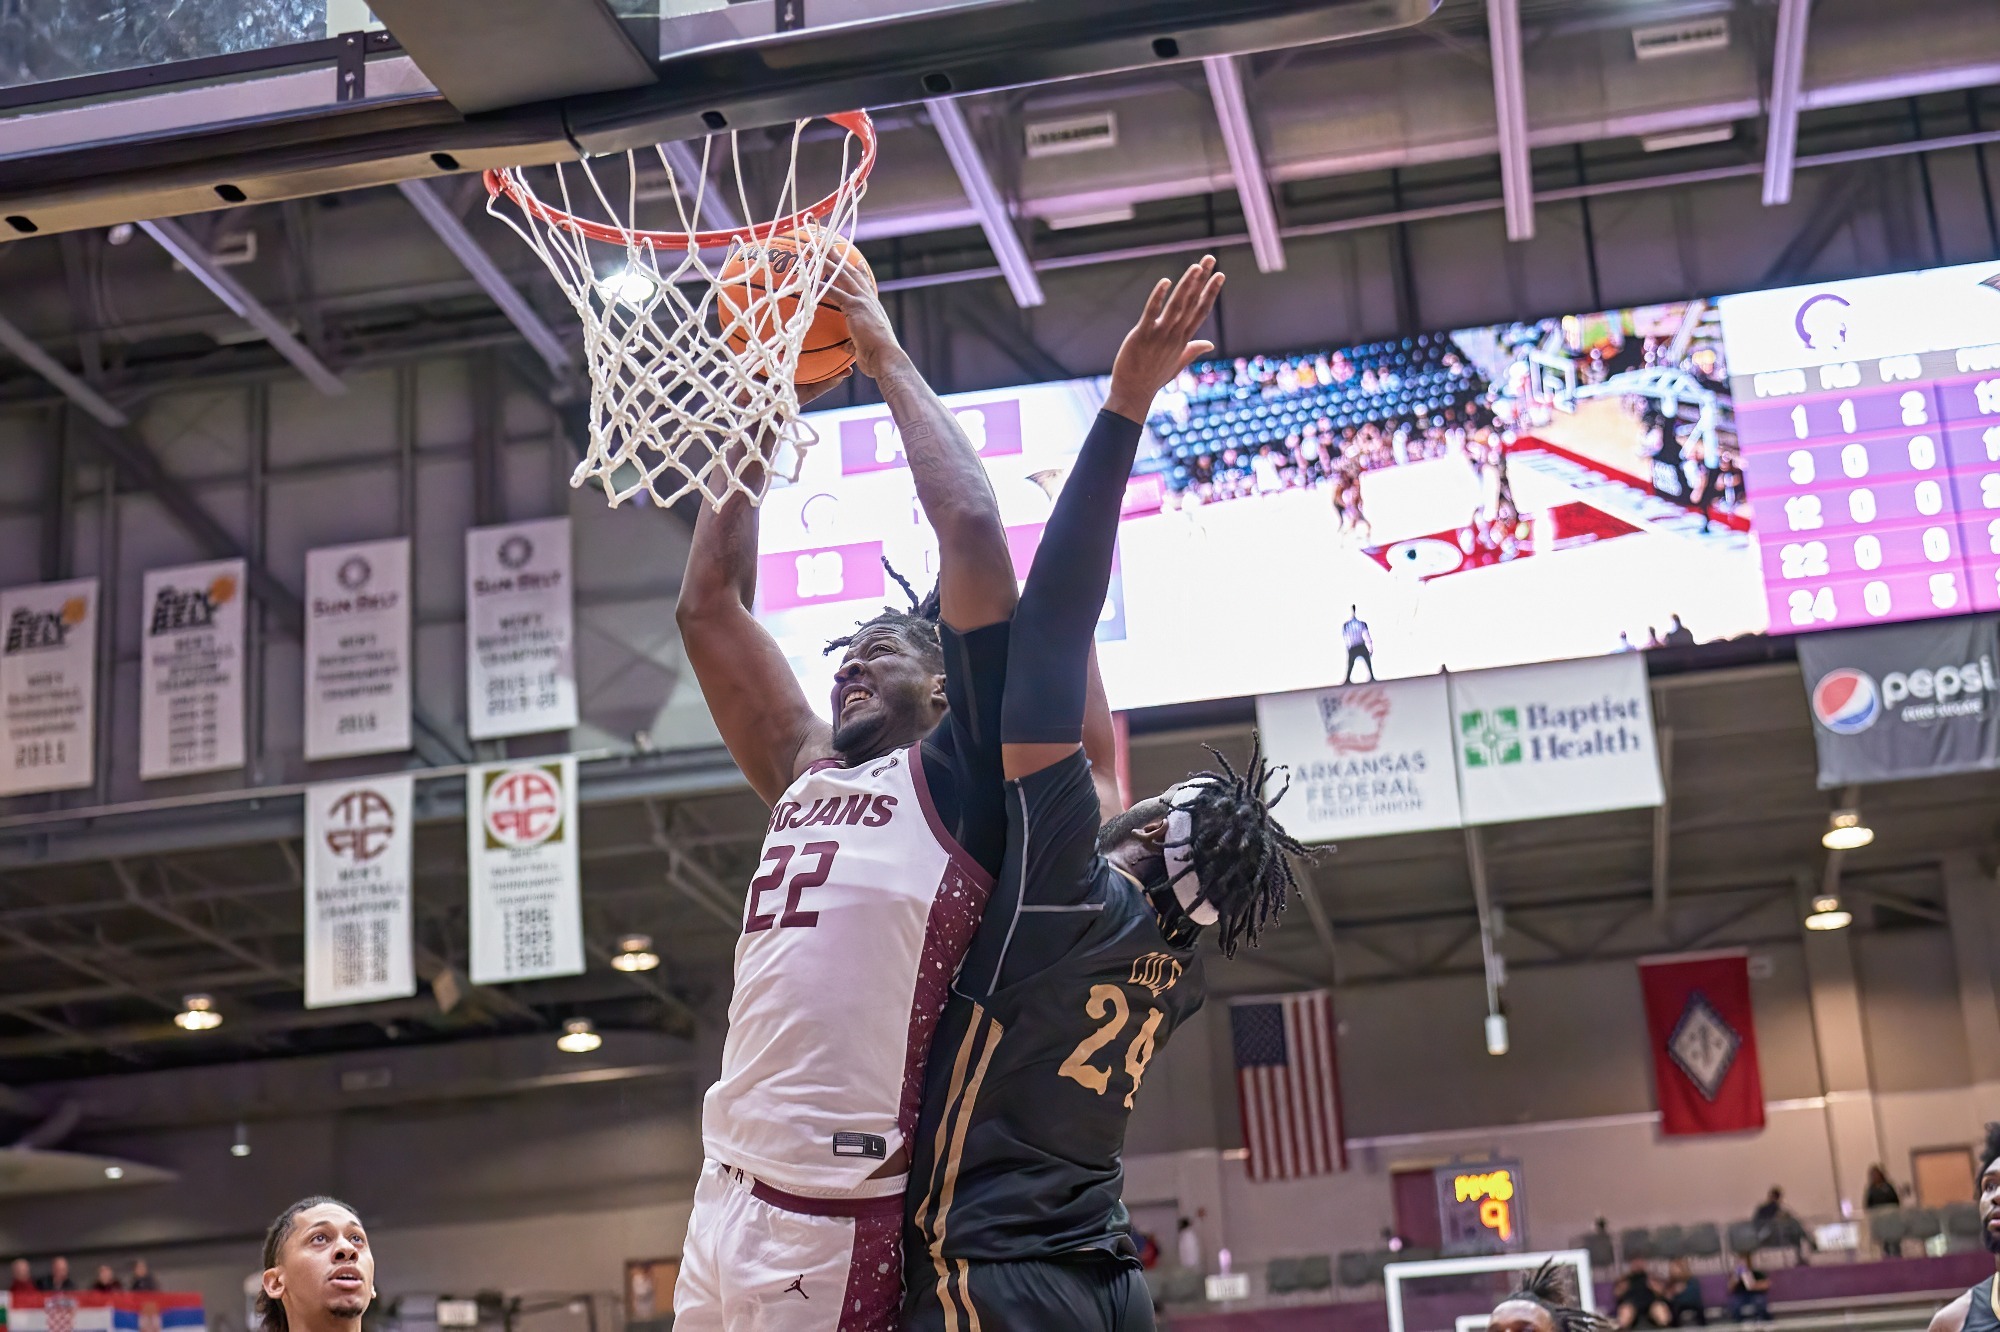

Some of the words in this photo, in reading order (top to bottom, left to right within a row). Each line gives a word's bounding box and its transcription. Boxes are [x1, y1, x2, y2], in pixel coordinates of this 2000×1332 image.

[1790, 404, 1809, 439] 1
[1838, 399, 1857, 433] 1
[1900, 390, 1928, 426] 2
[1841, 443, 1869, 478] 0
[1908, 435, 1936, 470] 0
[1849, 488, 1877, 523] 0
[1914, 480, 1943, 516] 0
[1780, 541, 1830, 579] 22
[1854, 534, 1882, 570] 0
[1922, 526, 1951, 562] 0
[1788, 586, 1837, 625] 24
[1863, 581, 1891, 617] 0
[1928, 572, 1958, 609] 5
[1881, 654, 1996, 711] pepsi
[1526, 697, 1641, 732] Baptist
[1530, 727, 1641, 762] Health
[1295, 752, 1427, 782] ARKANSAS
[1306, 778, 1420, 804] FEDERAL
[745, 841, 839, 934] 22
[1058, 984, 1164, 1110] 24
[872, 1141, 878, 1151] L
